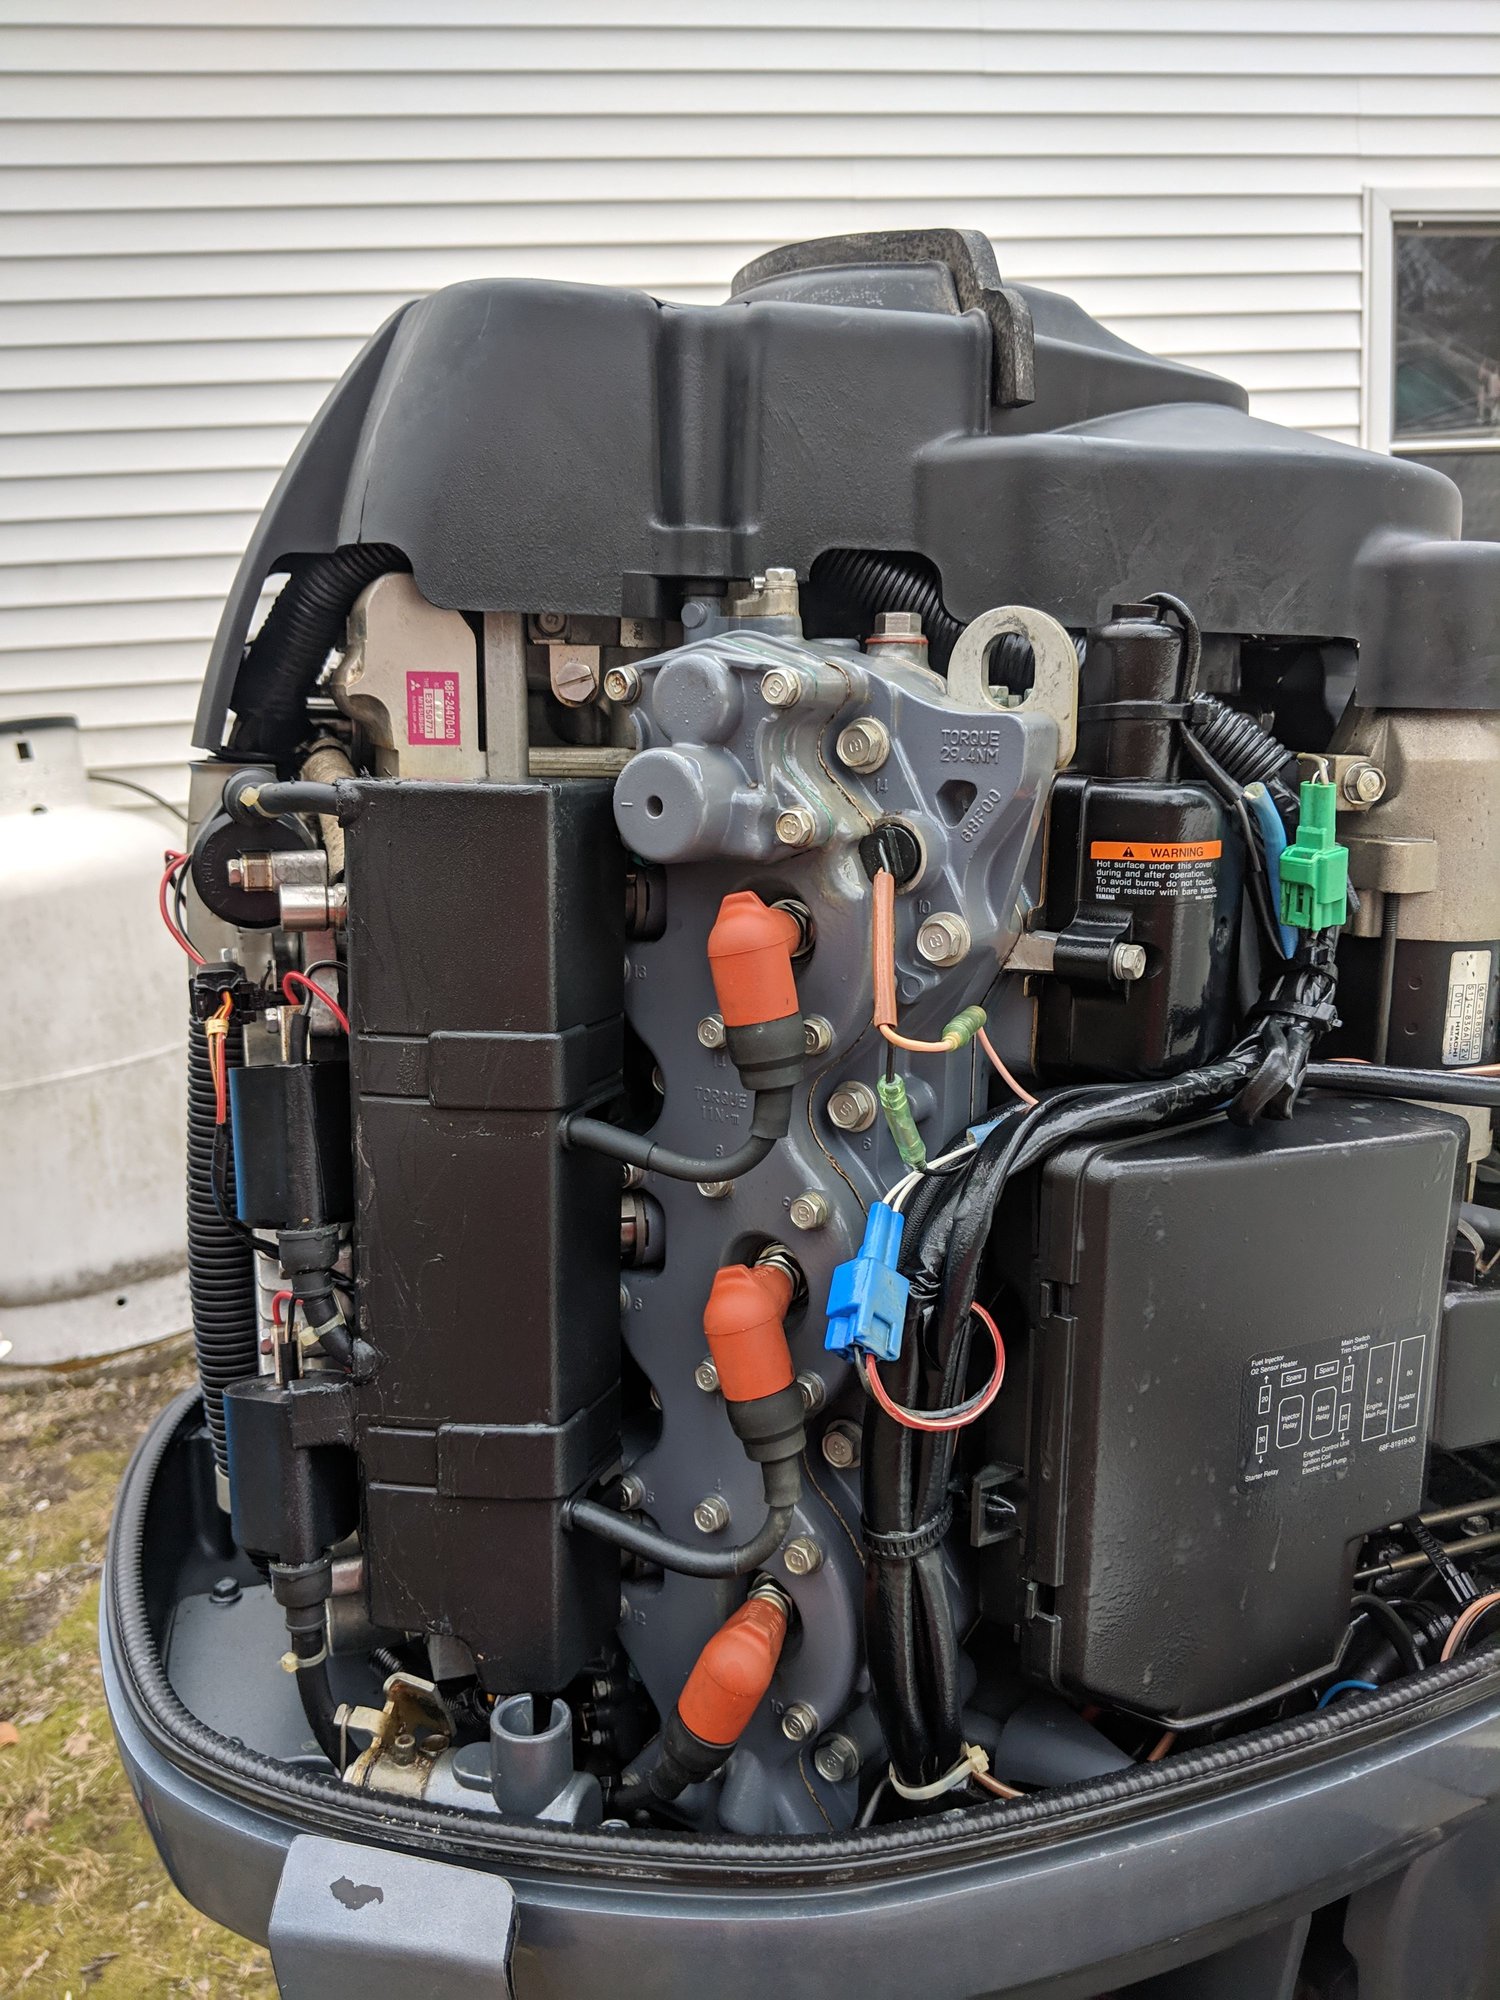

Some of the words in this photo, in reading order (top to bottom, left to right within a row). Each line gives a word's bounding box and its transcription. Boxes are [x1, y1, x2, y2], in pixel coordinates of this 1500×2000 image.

[444, 680, 456, 739] 68F-24470-00
[941, 729, 1000, 747] TORQUE
[940, 746, 999, 764] 29.4NM
[1150, 847, 1204, 858] WARNING
[1096, 860, 1111, 868] Hot
[1114, 861, 1145, 869] surface
[1096, 869, 1121, 878] during
[1125, 870, 1141, 878] and
[1110, 878, 1132, 886] avoid
[1135, 879, 1162, 888] burns,
[1195, 878, 1214, 886] touch
[1096, 885, 1121, 894] finned
[1124, 887, 1156, 896] resistor
[1160, 888, 1178, 896] with
[694, 1086, 748, 1108] TORQUE
[1341, 1339, 1354, 1347] Main
[1354, 1334, 1371, 1343] Switch
[1352, 1343, 1369, 1352] Switch
[1251, 1359, 1264, 1367] Fuel
[1264, 1355, 1285, 1364] Injector
[1260, 1364, 1279, 1374] Sensor
[1280, 1360, 1299, 1369] Heater
[1319, 1366, 1335, 1375] Spare
[1285, 1374, 1302, 1383] Spare
[1398, 1393, 1416, 1402] Isolator
[1366, 1402, 1383, 1411] Engine
[1397, 1402, 1410, 1410] Fuse
[1281, 1412, 1301, 1422] Injector
[1315, 1413, 1330, 1421] Relay
[1341, 1413, 1348, 1421] 20
[1365, 1411, 1376, 1419] Main
[1376, 1408, 1388, 1416] Fuse
[1282, 1422, 1298, 1430] Relay
[1303, 1449, 1321, 1458] Engine
[1321, 1442, 1339, 1453] Control
[1302, 1457, 1321, 1467] Ignition
[1321, 1452, 1331, 1461] Coil
[1302, 1465, 1321, 1475] Electric
[1321, 1460, 1332, 1469] Fuel
[1332, 1457, 1348, 1465] Pump
[1245, 1473, 1264, 1482] Starter
[1263, 1469, 1279, 1477] Relay
